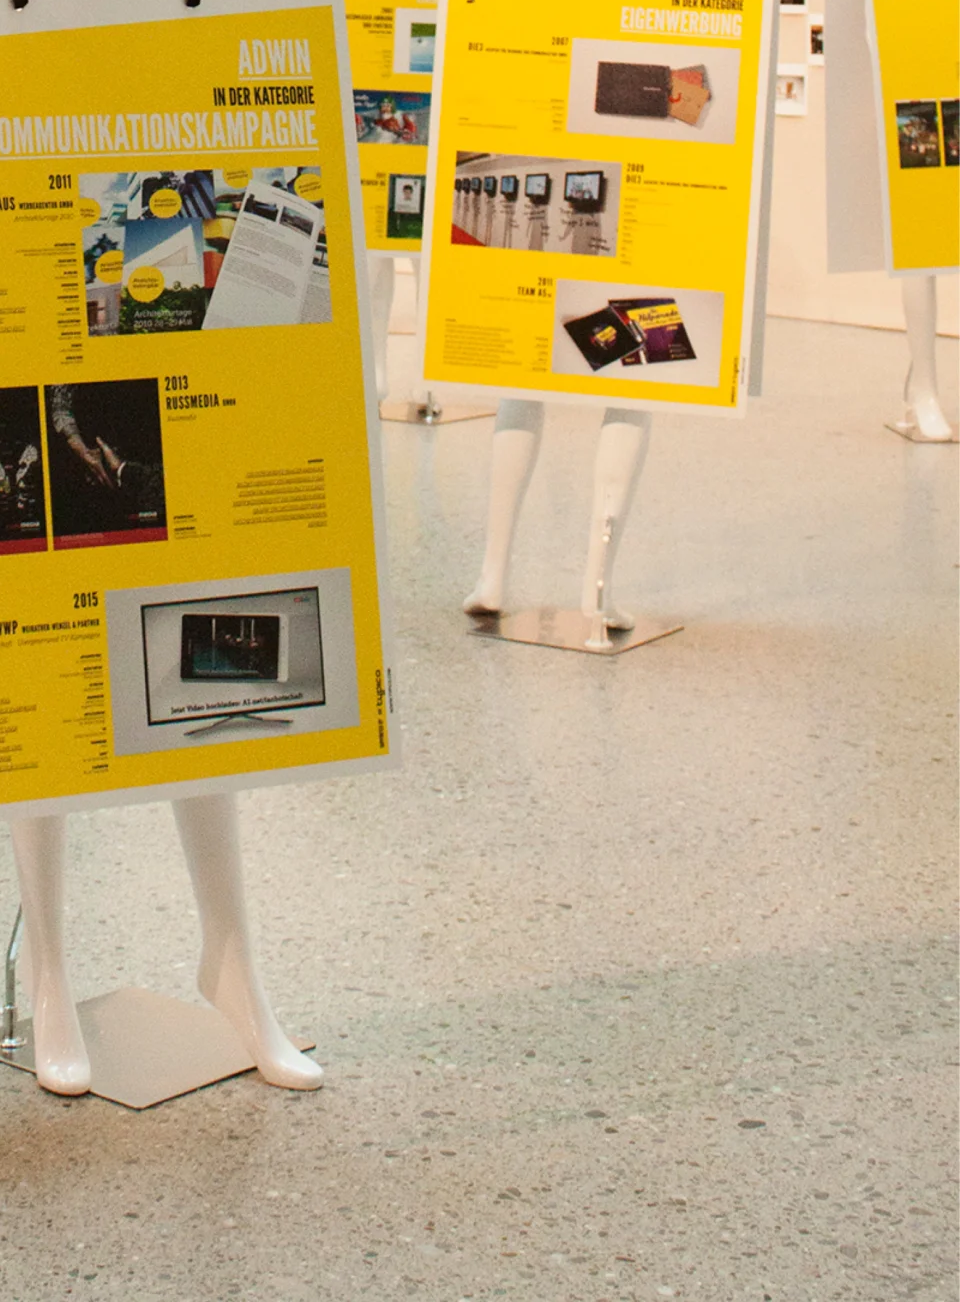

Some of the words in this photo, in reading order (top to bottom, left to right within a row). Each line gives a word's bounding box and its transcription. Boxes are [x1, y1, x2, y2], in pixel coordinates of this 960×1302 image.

[620, 5, 743, 37] EIGENWERBUNG
[239, 38, 312, 75] ADWIN
[213, 87, 227, 107] IN
[229, 87, 252, 106] DER
[253, 85, 315, 106] KATEGORIE
[48, 174, 72, 190] 2011
[165, 375, 189, 391] 2013
[166, 393, 220, 410] RUSSMEDIA
[73, 591, 99, 609] 2015
